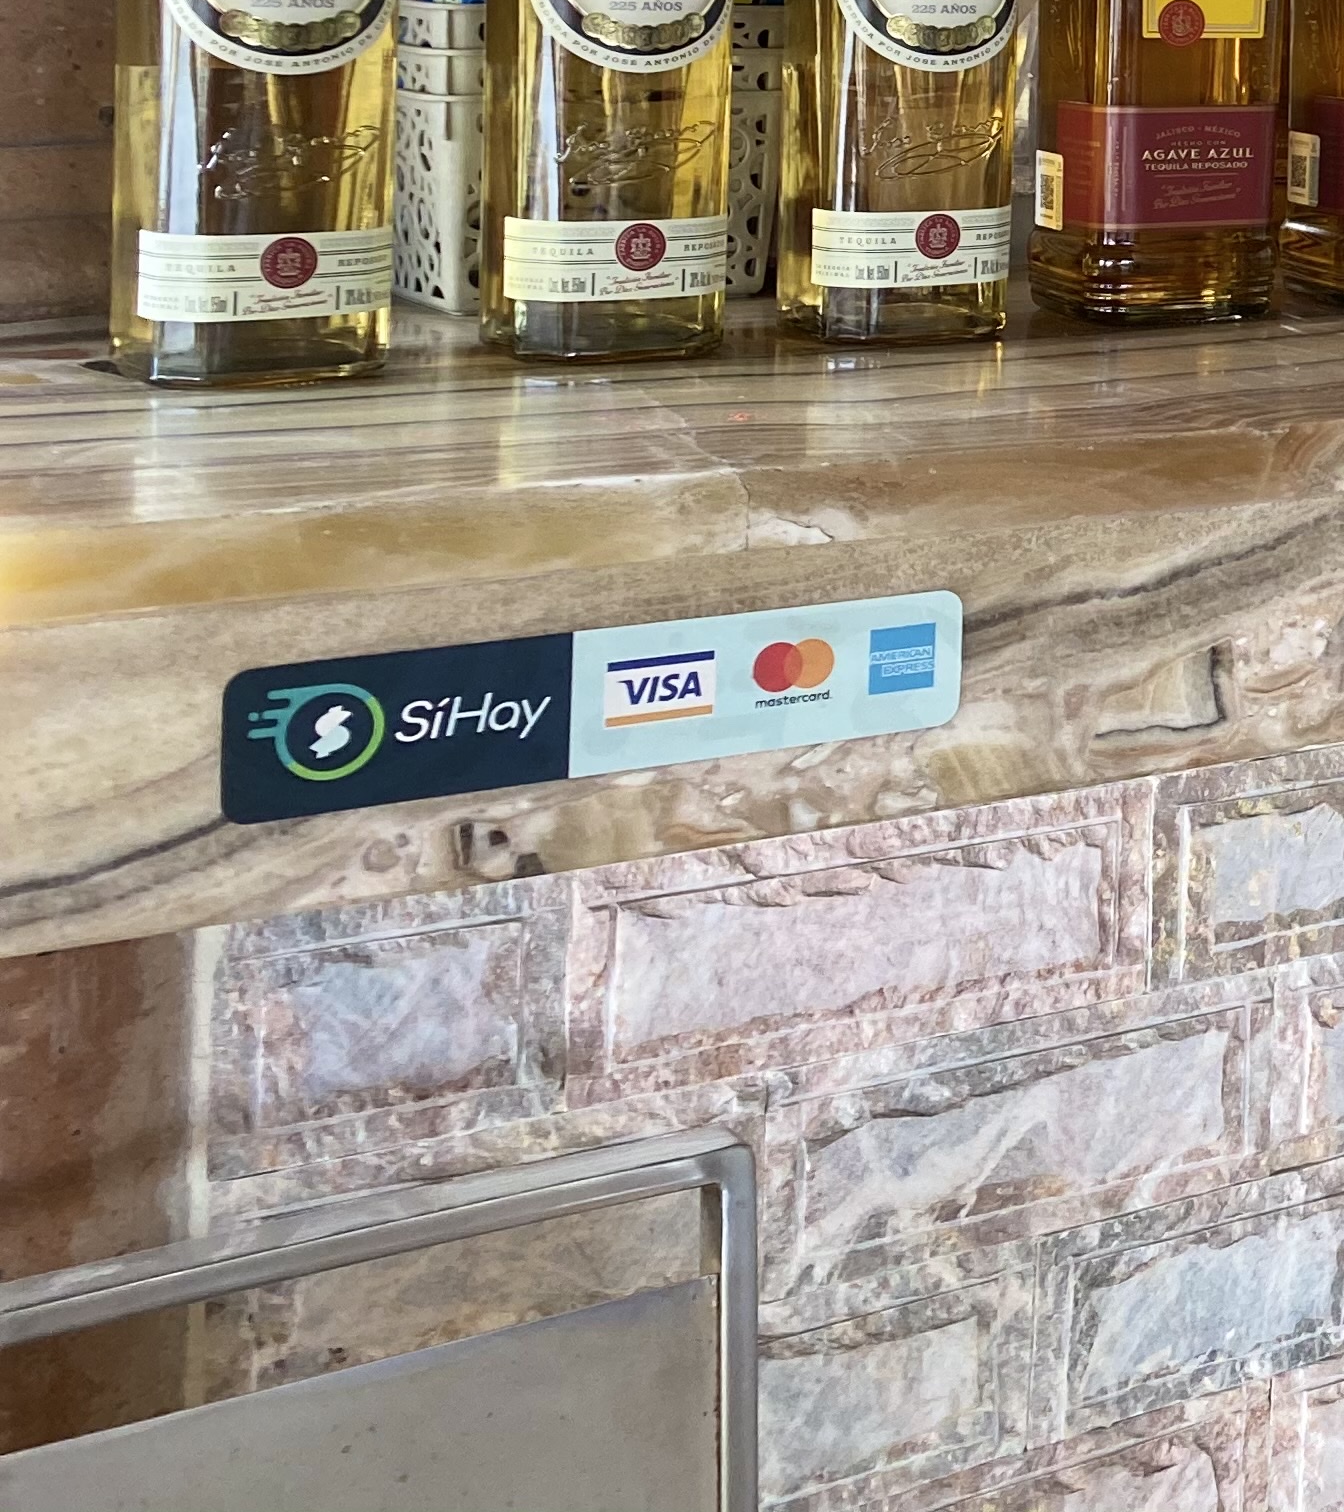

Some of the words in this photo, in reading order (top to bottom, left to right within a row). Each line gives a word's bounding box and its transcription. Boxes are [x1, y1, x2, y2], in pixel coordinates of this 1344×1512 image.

[609, 1, 637, 11] 225
[641, 0, 683, 12] AÑOS
[911, 5, 937, 14] 225
[940, 2, 977, 15] AÑOS
[1141, 148, 1201, 161] AGAVE
[1207, 147, 1255, 159] AZUL
[1144, 163, 1189, 171] TEQUILA
[1191, 161, 1248, 170] REPOSADO
[839, 236, 897, 247] TEQUILA
[870, 646, 932, 664] AMERICAN
[883, 660, 936, 676] EXPRESS
[617, 671, 702, 706] VISA
[754, 689, 832, 709] mastercard
